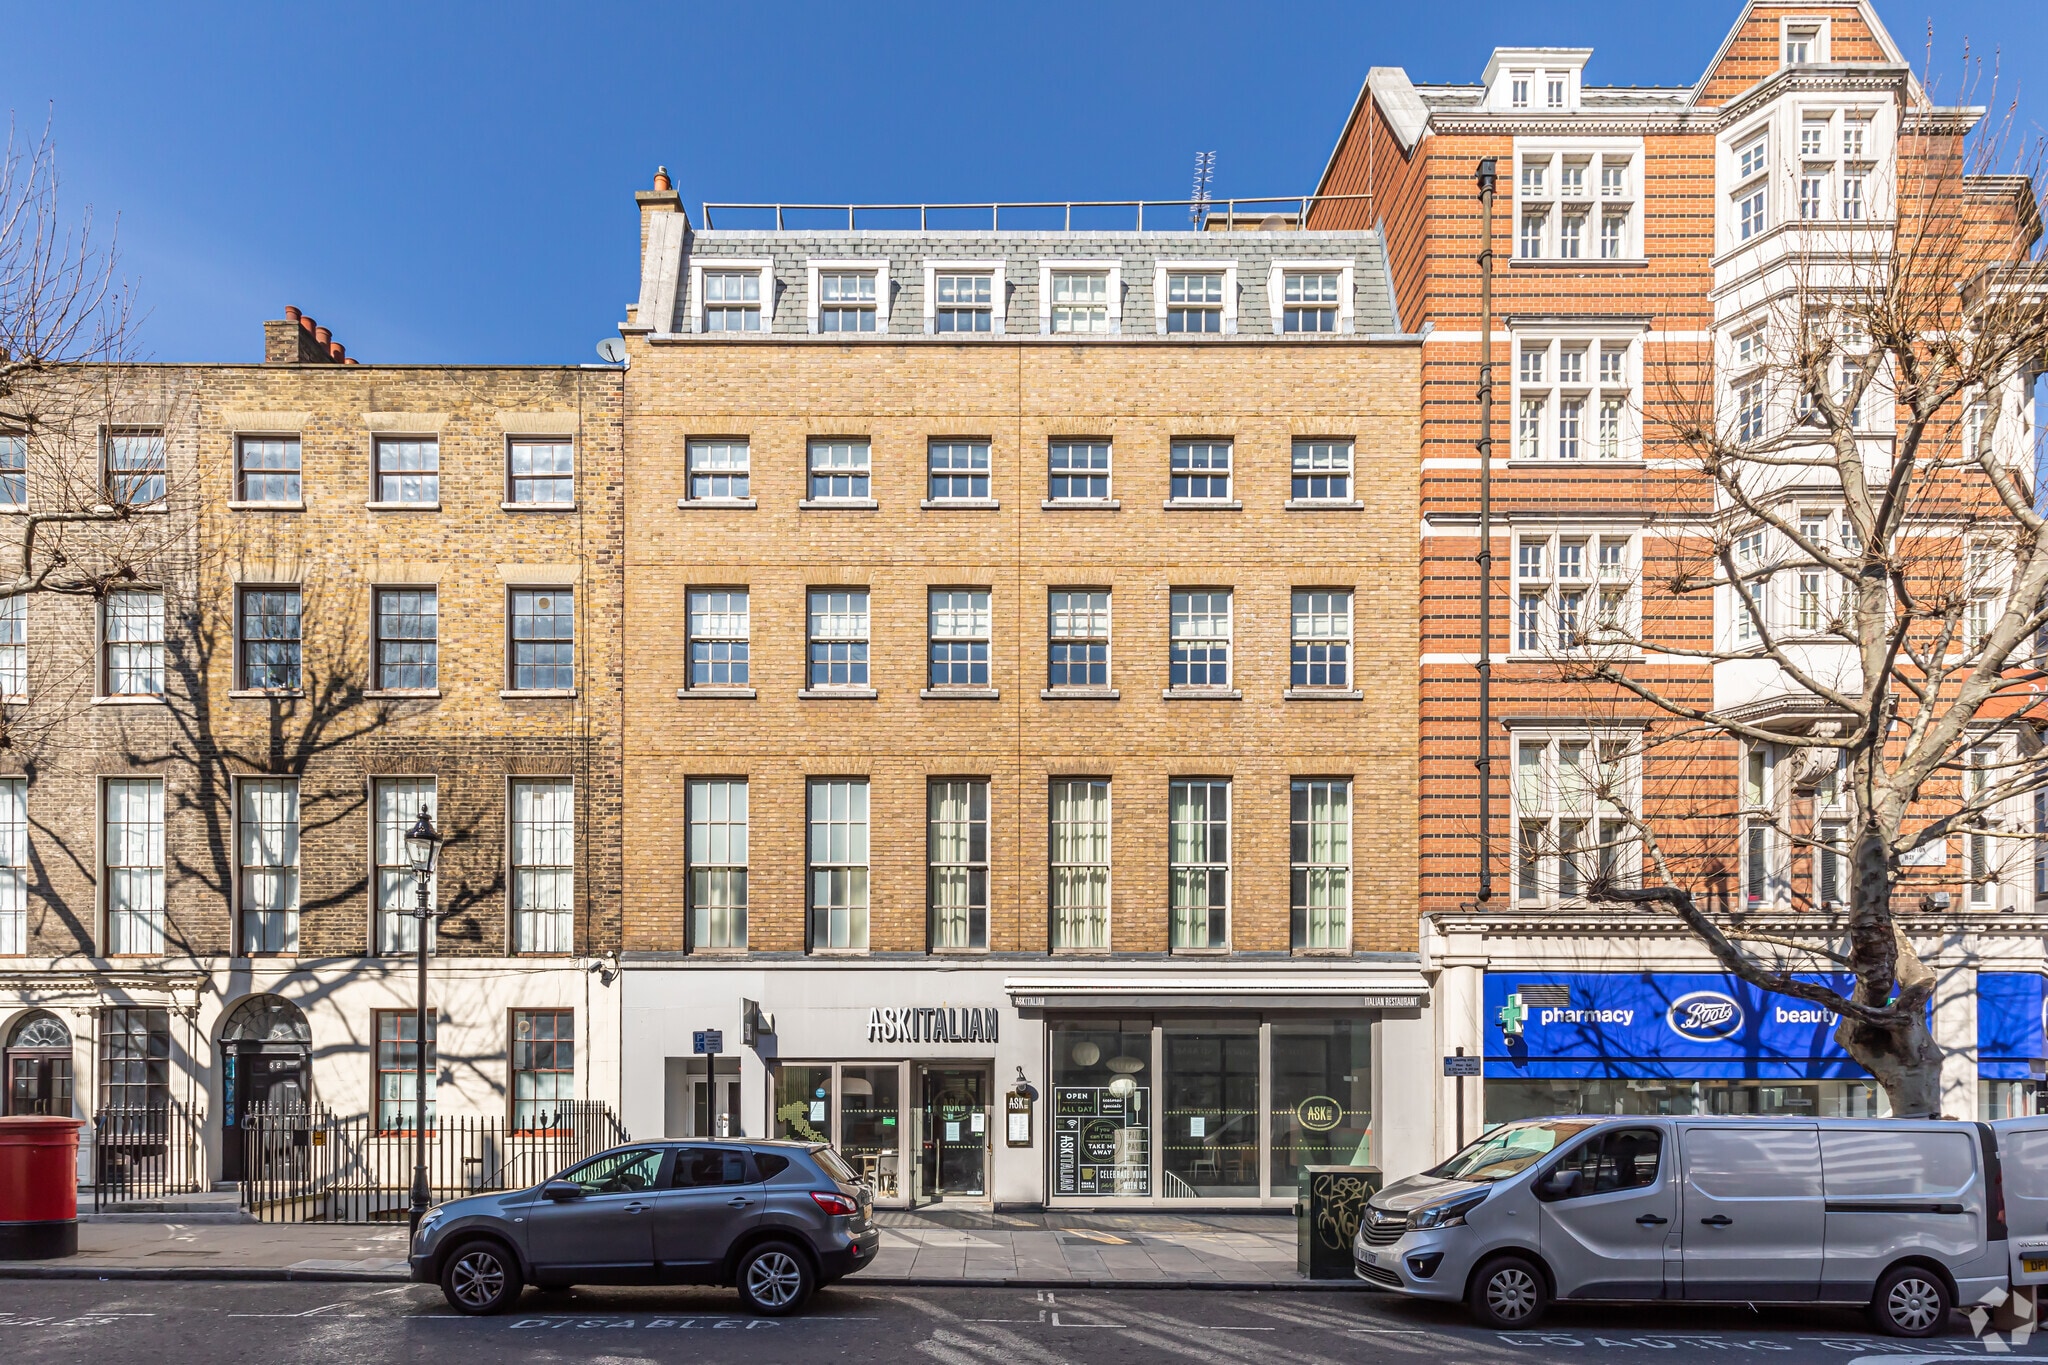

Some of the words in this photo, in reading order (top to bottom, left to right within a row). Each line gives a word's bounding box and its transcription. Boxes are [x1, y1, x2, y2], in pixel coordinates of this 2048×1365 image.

[1364, 997, 1385, 1006] ITALIAN
[1385, 997, 1418, 1006] RESTAURANT
[1541, 1006, 1634, 1026] pharmacy
[1681, 1003, 1733, 1029] Boots
[1776, 1007, 1838, 1026] beauty
[697, 1033, 703, 1042] P
[1009, 1097, 1024, 1109] ASK
[1307, 1106, 1326, 1121] ASK
[1060, 1135, 1074, 1190] ASKITALIAN
[1100, 1170, 1130, 1179] CELEBRATE
[1132, 1170, 1147, 1179] YOUR
[1123, 1181, 1138, 1190] WITH
[1139, 1181, 1147, 1190] US
[509, 1319, 780, 1329] DISABLED
[1498, 1335, 1793, 1352] LOADING
